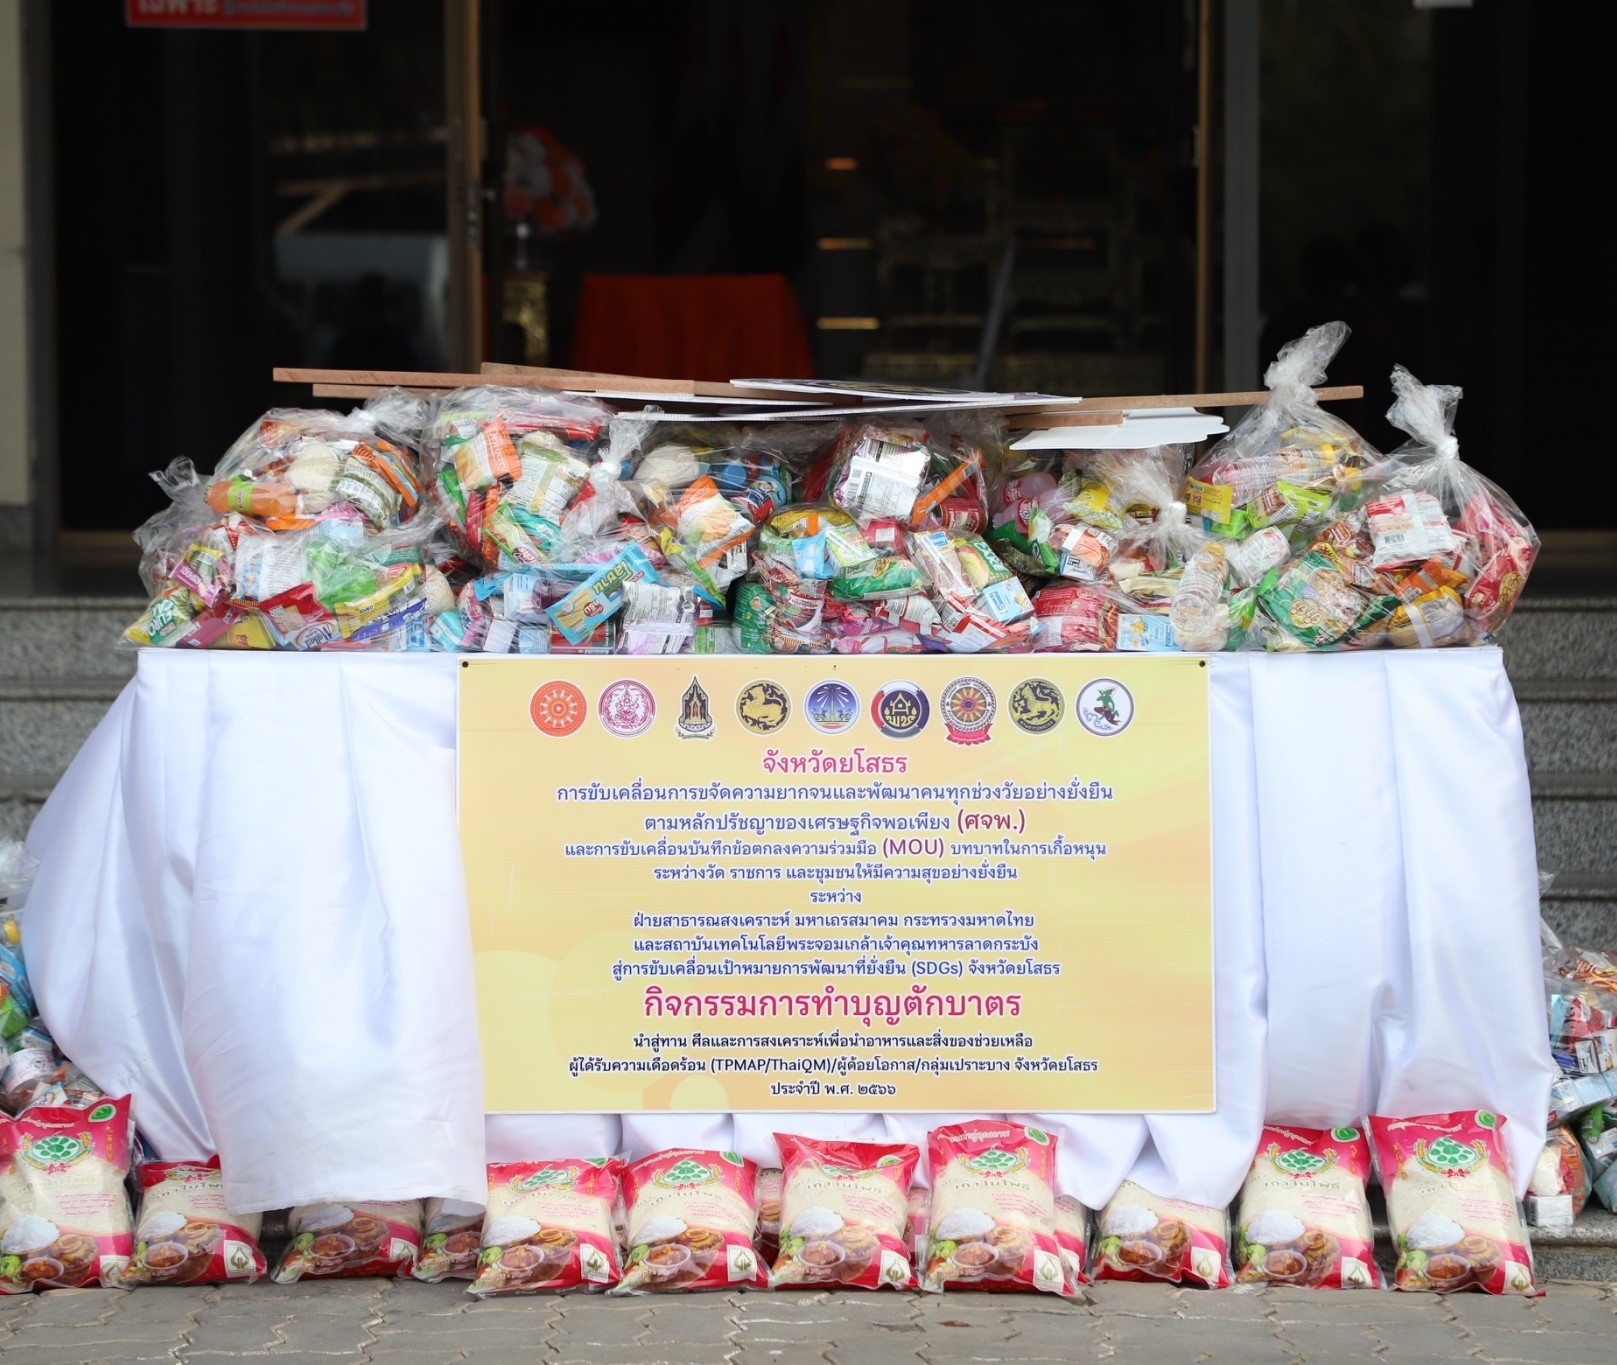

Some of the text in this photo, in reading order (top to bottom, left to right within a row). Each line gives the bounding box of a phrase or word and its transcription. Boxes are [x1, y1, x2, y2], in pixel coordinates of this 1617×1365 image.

[763, 747, 908, 773] จังหวัดยโสธร
[557, 777, 1113, 805] การขับเคลื่อนการขจัดความยากจนและพัฒนาคนทุกช่วงวัยอย่างยั่งยืน
[645, 808, 1025, 837] ตามหลักปรัชญาของเศรษฐกิจพอเพียง (ศจพ.)
[565, 836, 1106, 861] และการขับเคลื่อนบันทึกข้อตกลงความร่วมมือ (MOU) บทบาทในการเกื้อหนุน
[654, 861, 1018, 884] ระหว่างวัด ราชการ และชุมชนให้มีความสุขอย่างยั่งยืน
[810, 886, 862, 903] ระหว่าง
[633, 910, 1034, 928] ฝ่ายสาธารณสงเคราะห์ มหาเถรสมาคม กระทรวงมหาดไทย
[633, 934, 1038, 956] และสถาบันเทคโนโลยีพระจอมเกล้าเจ้าคุณทหารลาดกระบัง
[612, 956, 1060, 981] สู่การขับเคลื่อนเป้าหมายการพัฒนาที่ยั่งยืน (SDGs) จังหวัดยโสธร
[644, 984, 1022, 1028] กิจกรรมการทำบุญตักบาตร
[633, 1029, 1033, 1053] นำสู่ทาน ศีลและการสงเคราะห์เพื่อนำอาหารและสิ่งของช่วยเหลือ
[569, 1055, 1099, 1077] ผู้ได้รับความเดือดร้อน (TPMAP/ThaiQM)/ผู้ด้อยโอกาส/กลุ่มเปราะบาง จังหวัดยโสธร
[770, 1080, 896, 1096] ประจำปี พ.ศ. ๒๕๖๖
